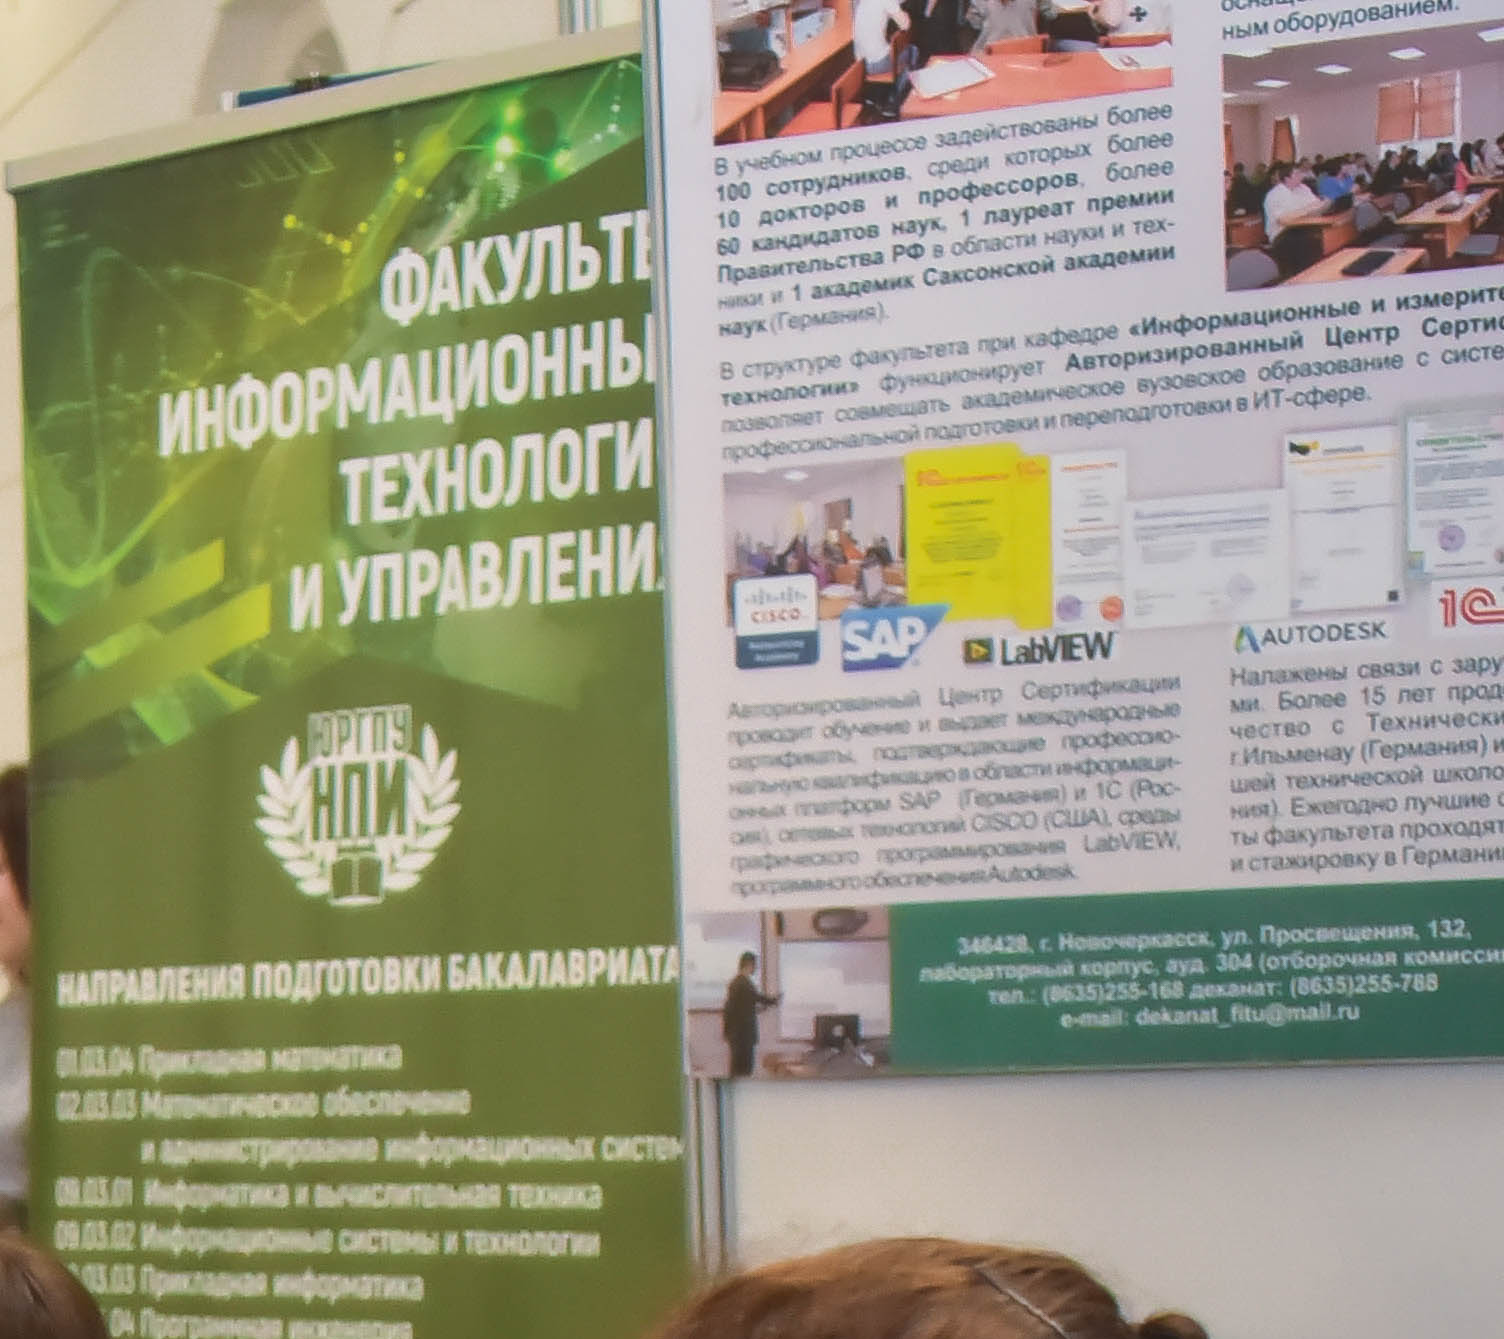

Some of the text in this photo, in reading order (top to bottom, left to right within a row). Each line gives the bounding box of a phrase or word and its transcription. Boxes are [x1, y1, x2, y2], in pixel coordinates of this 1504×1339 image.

[1222, 0, 1459, 40] ным оборудованием.
[716, 189, 1174, 256] 60 кандидатов наук, 1 лауреат премии
[721, 382, 858, 406] технологии»
[880, 360, 1043, 393] функционирует
[1065, 330, 1303, 371] Авторизированный
[1325, 325, 1399, 349] Центр
[743, 355, 840, 378] структуре
[850, 341, 968, 368] факультета
[978, 336, 1015, 355] при
[1025, 325, 1118, 349] кафедре
[1129, 300, 1361, 337] «Информационные
[1371, 298, 1384, 312] и
[340, 417, 654, 526] ТЕХНОЛОГИ
[289, 522, 665, 632] И УПРАВЛЕНИ
[843, 617, 930, 662] SAP
[1001, 632, 1114, 666] LabVIEW
[1261, 621, 1388, 646] AUTODESK
[310, 759, 410, 844] НПИ
[57, 944, 679, 1007] НАПРАВЛЕНИЯ ПОДГОТОВКИ БАКАЛАВРИАТА
